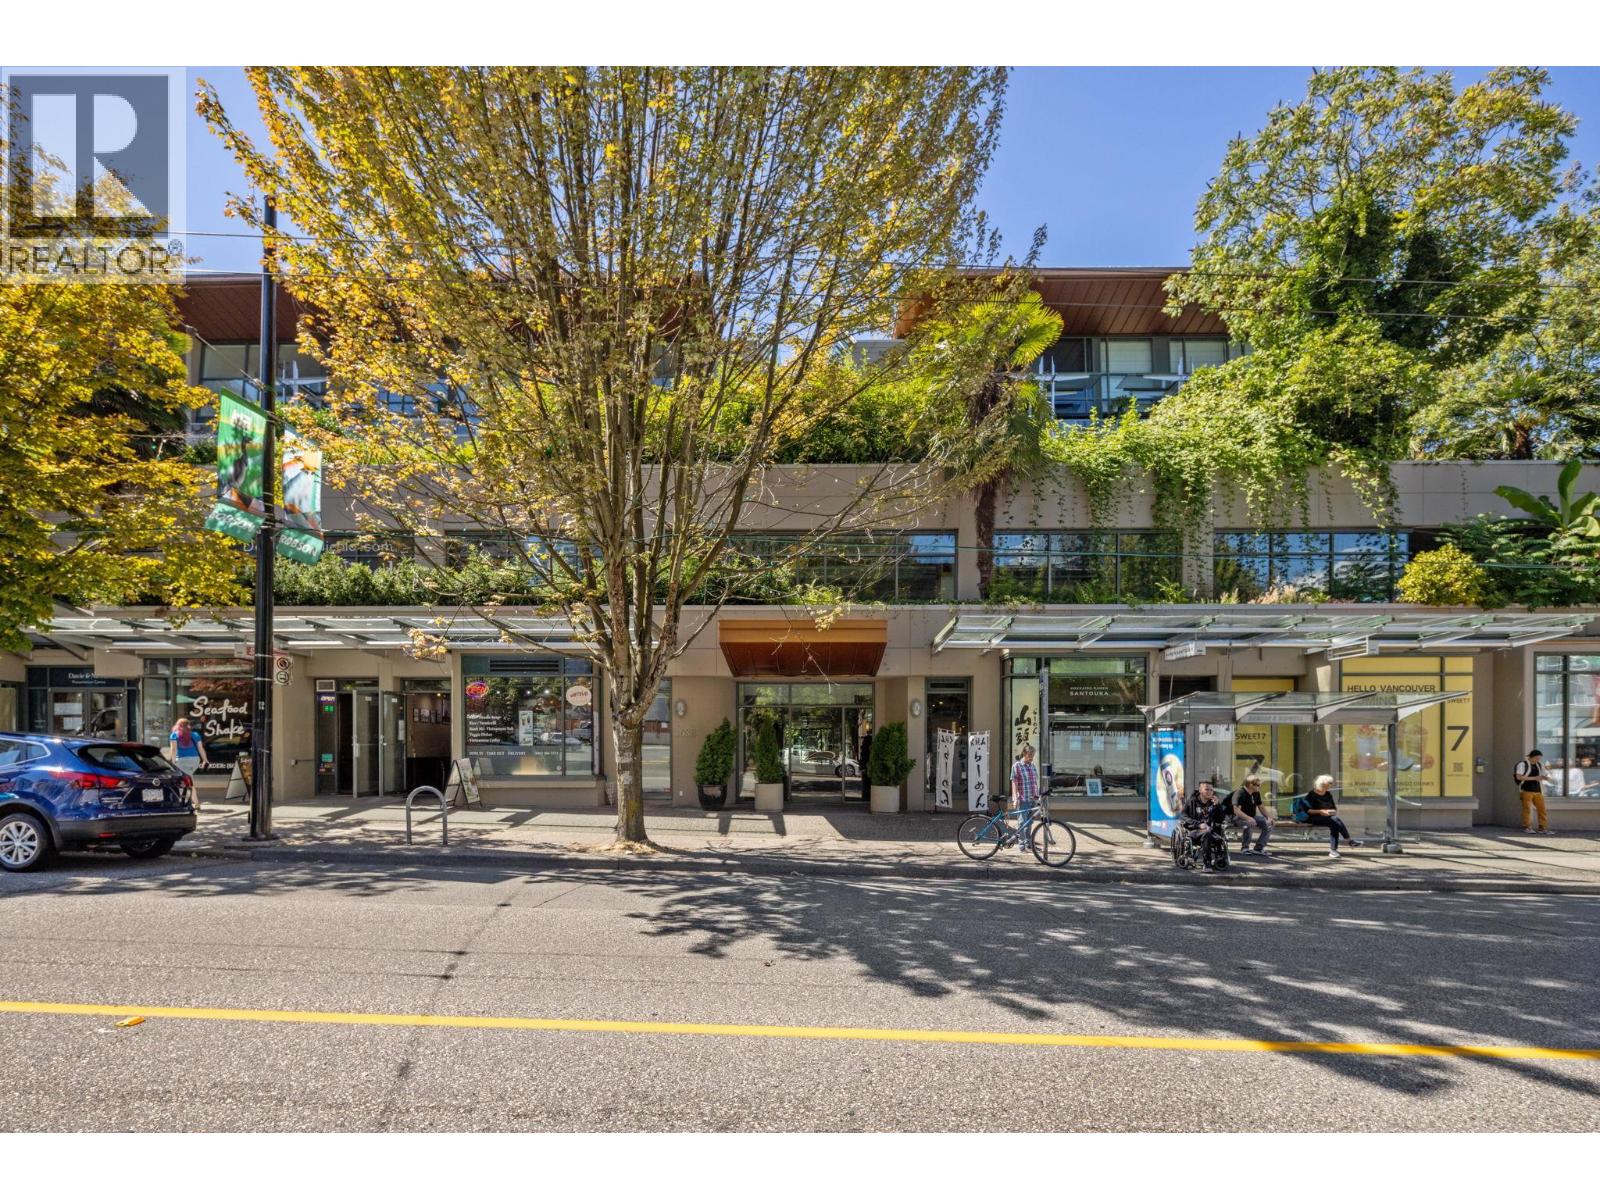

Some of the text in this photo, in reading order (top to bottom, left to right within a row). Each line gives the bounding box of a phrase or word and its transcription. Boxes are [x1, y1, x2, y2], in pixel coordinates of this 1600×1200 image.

[279, 534, 318, 557] ROBSON
[1347, 684, 1436, 694] HELLO VANCOUVER
[189, 695, 249, 721] Seafood
[204, 718, 245, 740] Shake
[1235, 732, 1266, 741] SWEET7
[1446, 725, 1470, 752] 7
[974, 751, 985, 808] らーめん
